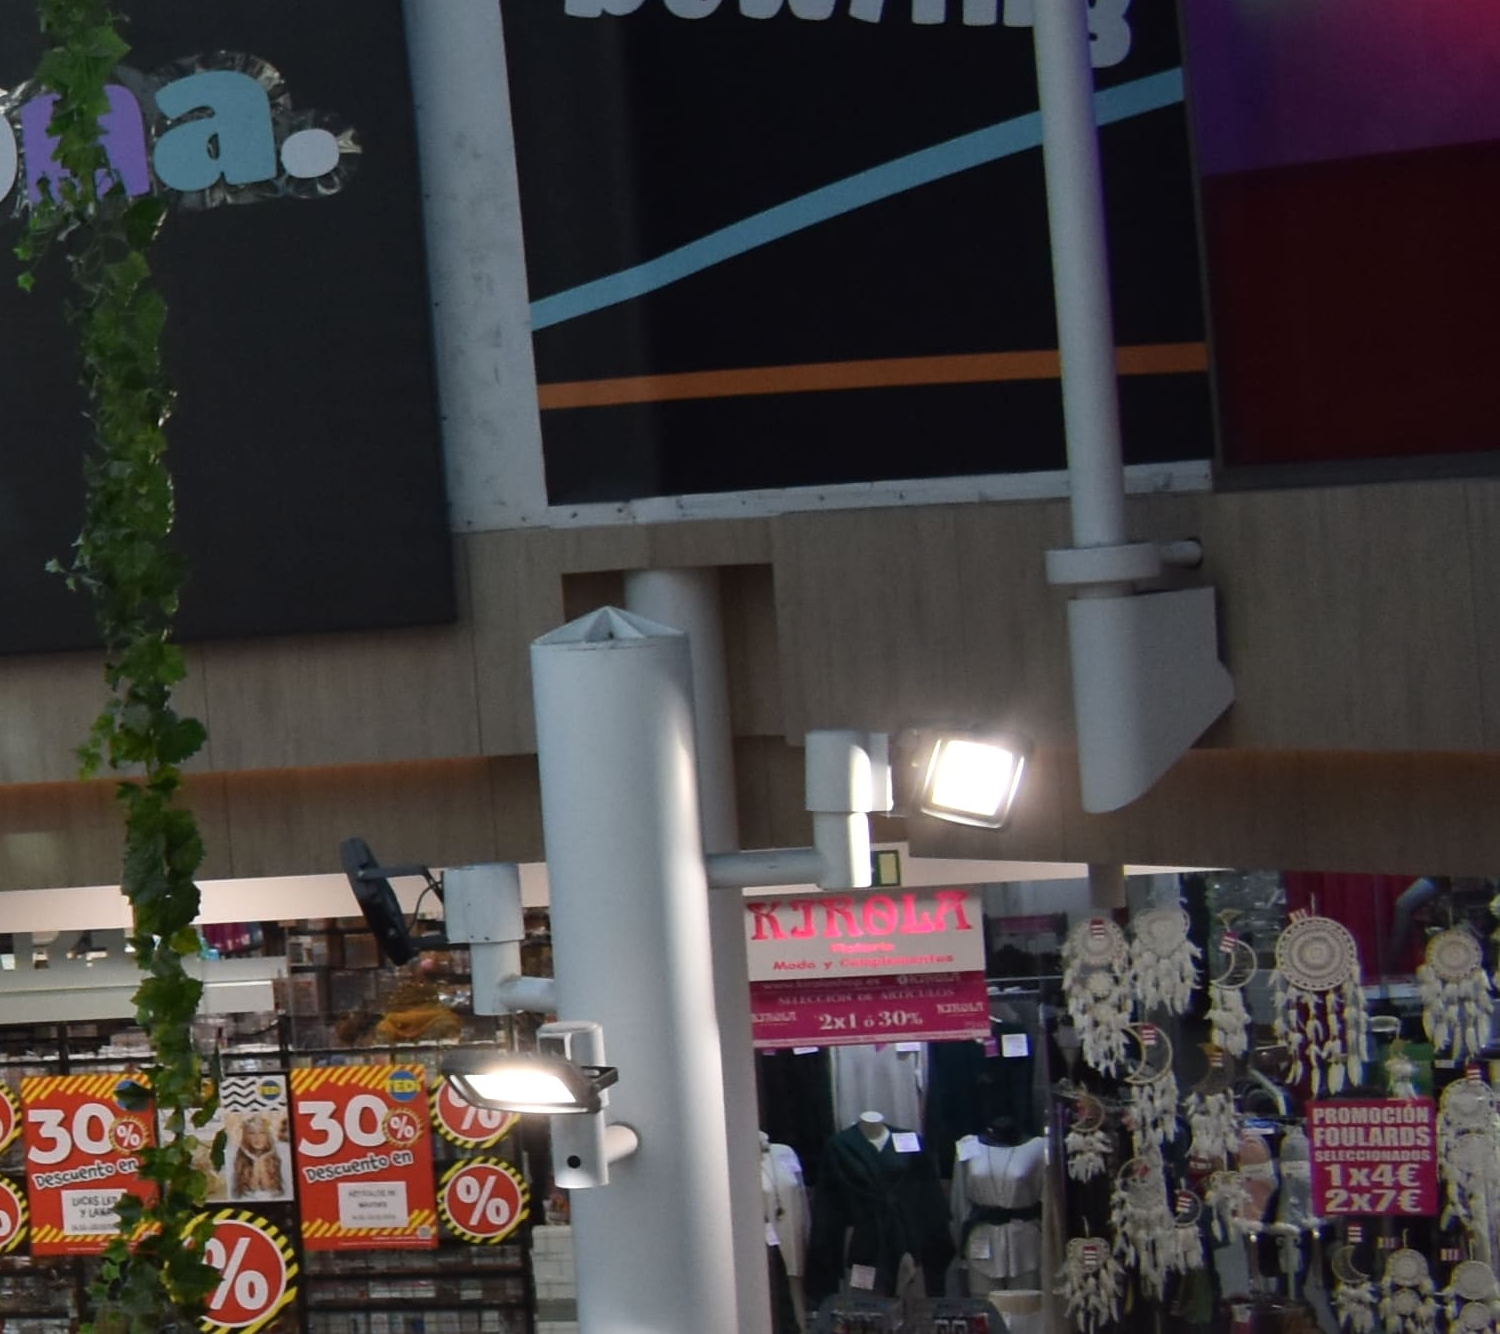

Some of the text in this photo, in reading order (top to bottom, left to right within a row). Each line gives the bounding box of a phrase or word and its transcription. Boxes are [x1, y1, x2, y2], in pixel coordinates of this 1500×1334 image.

[1312, 1103, 1429, 1125] PROMOCIÓN
[1313, 1125, 1430, 1147] FOULARDS
[35, 1158, 139, 1188] Descuento en
[305, 1150, 414, 1182] Descuento en
[1324, 1163, 1421, 1187] 1x4€
[1325, 1188, 1423, 1212] 2x7€
